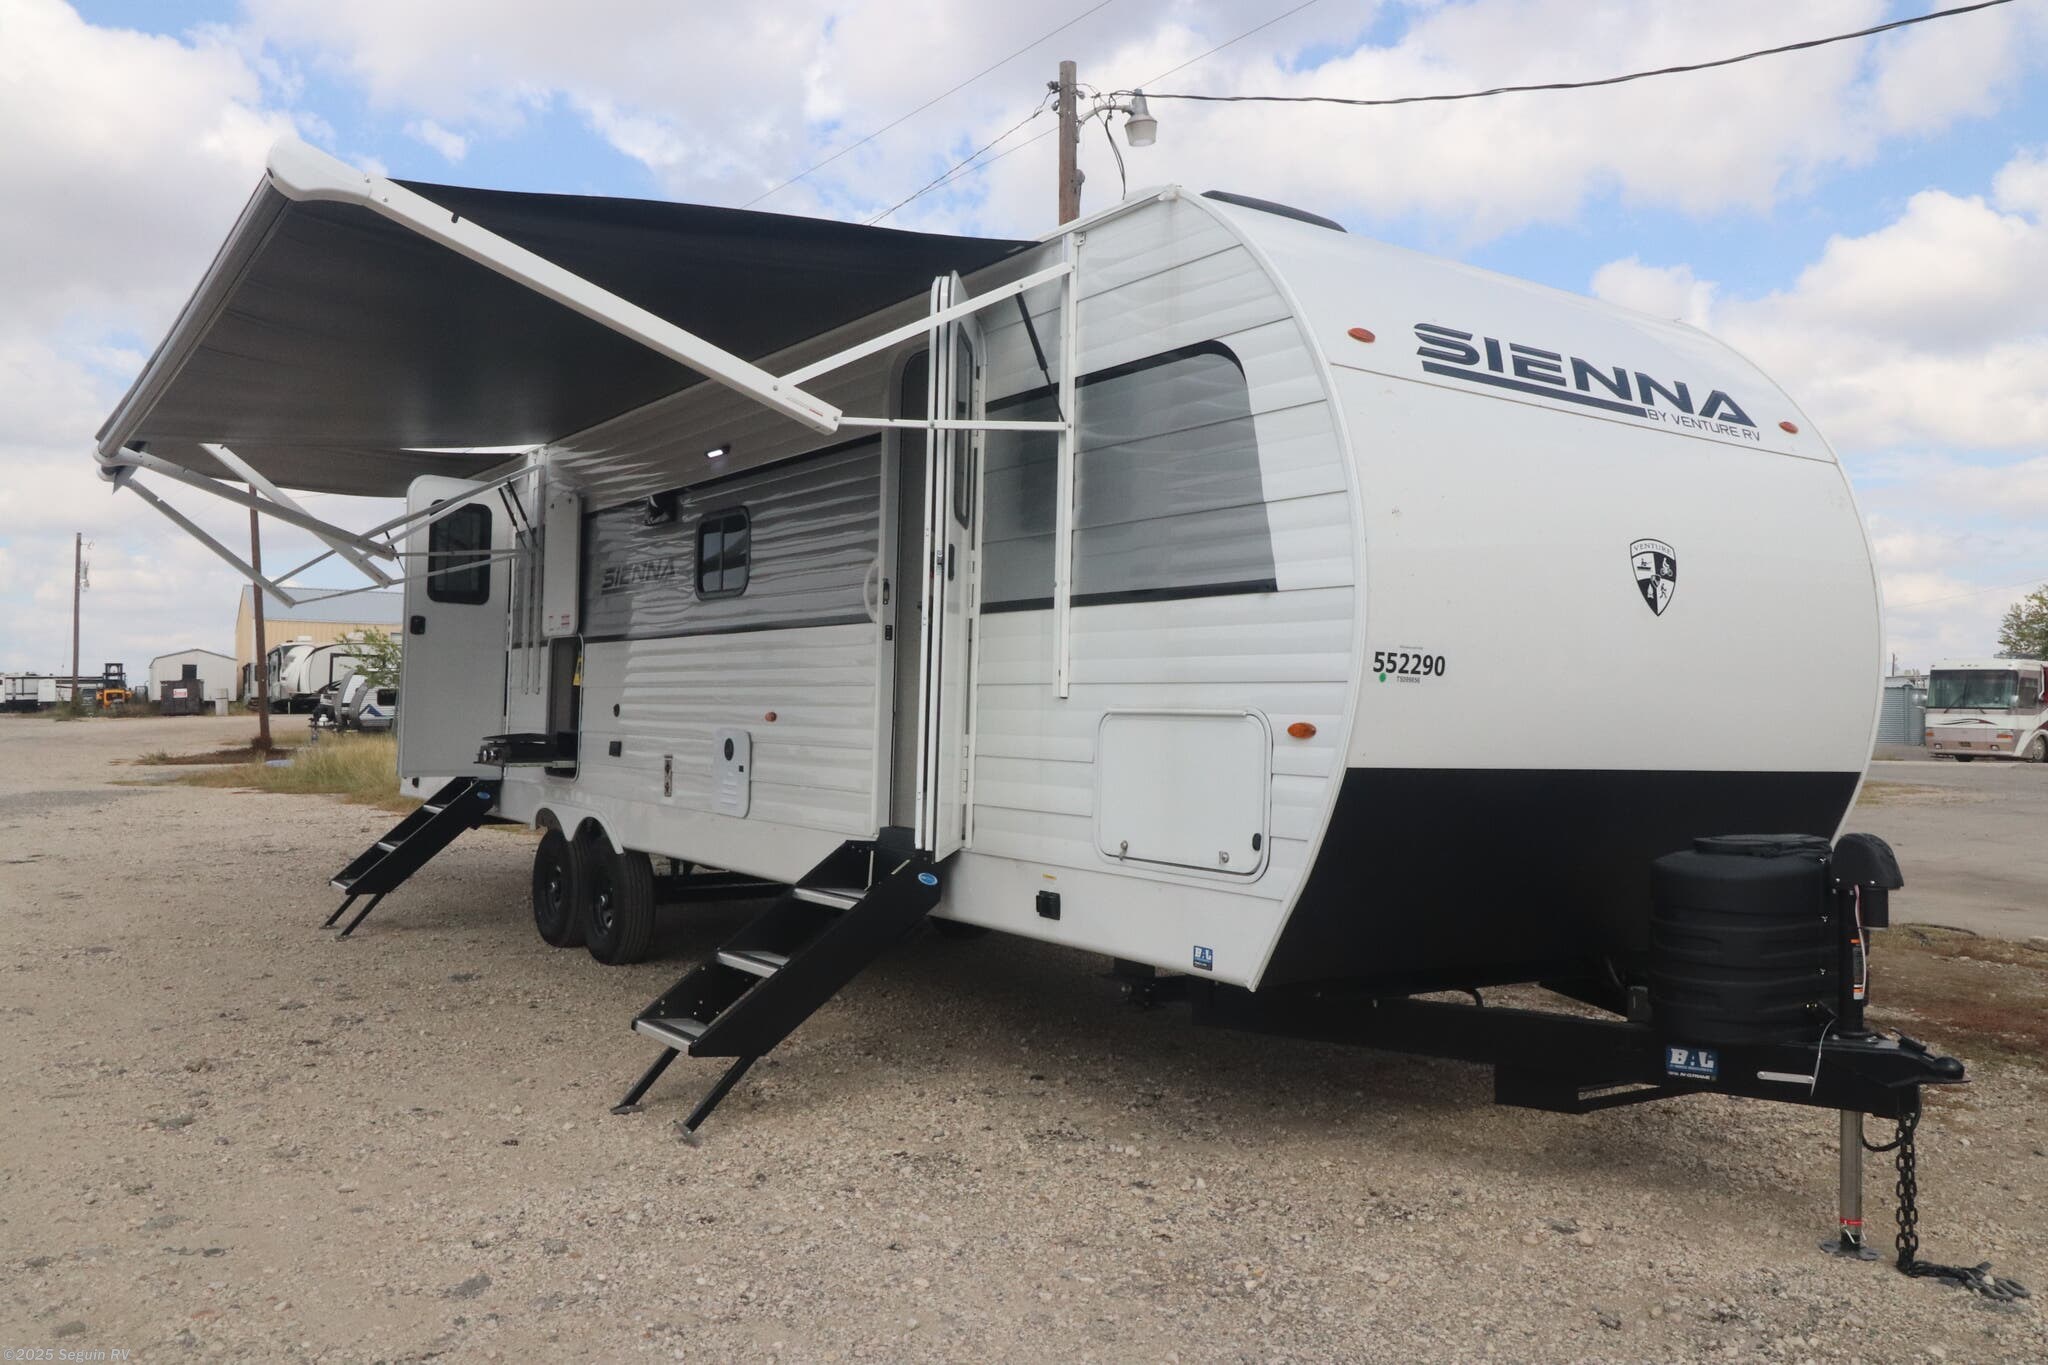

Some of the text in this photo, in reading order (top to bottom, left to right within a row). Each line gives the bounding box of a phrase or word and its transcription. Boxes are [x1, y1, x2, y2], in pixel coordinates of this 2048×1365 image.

[1413, 322, 1758, 428] SIENNA
[1647, 408, 1761, 442] BY VENTURE RV
[1633, 542, 1672, 555] VENTURE
[602, 557, 677, 590] SIENNA
[1373, 651, 1446, 677] 552290
